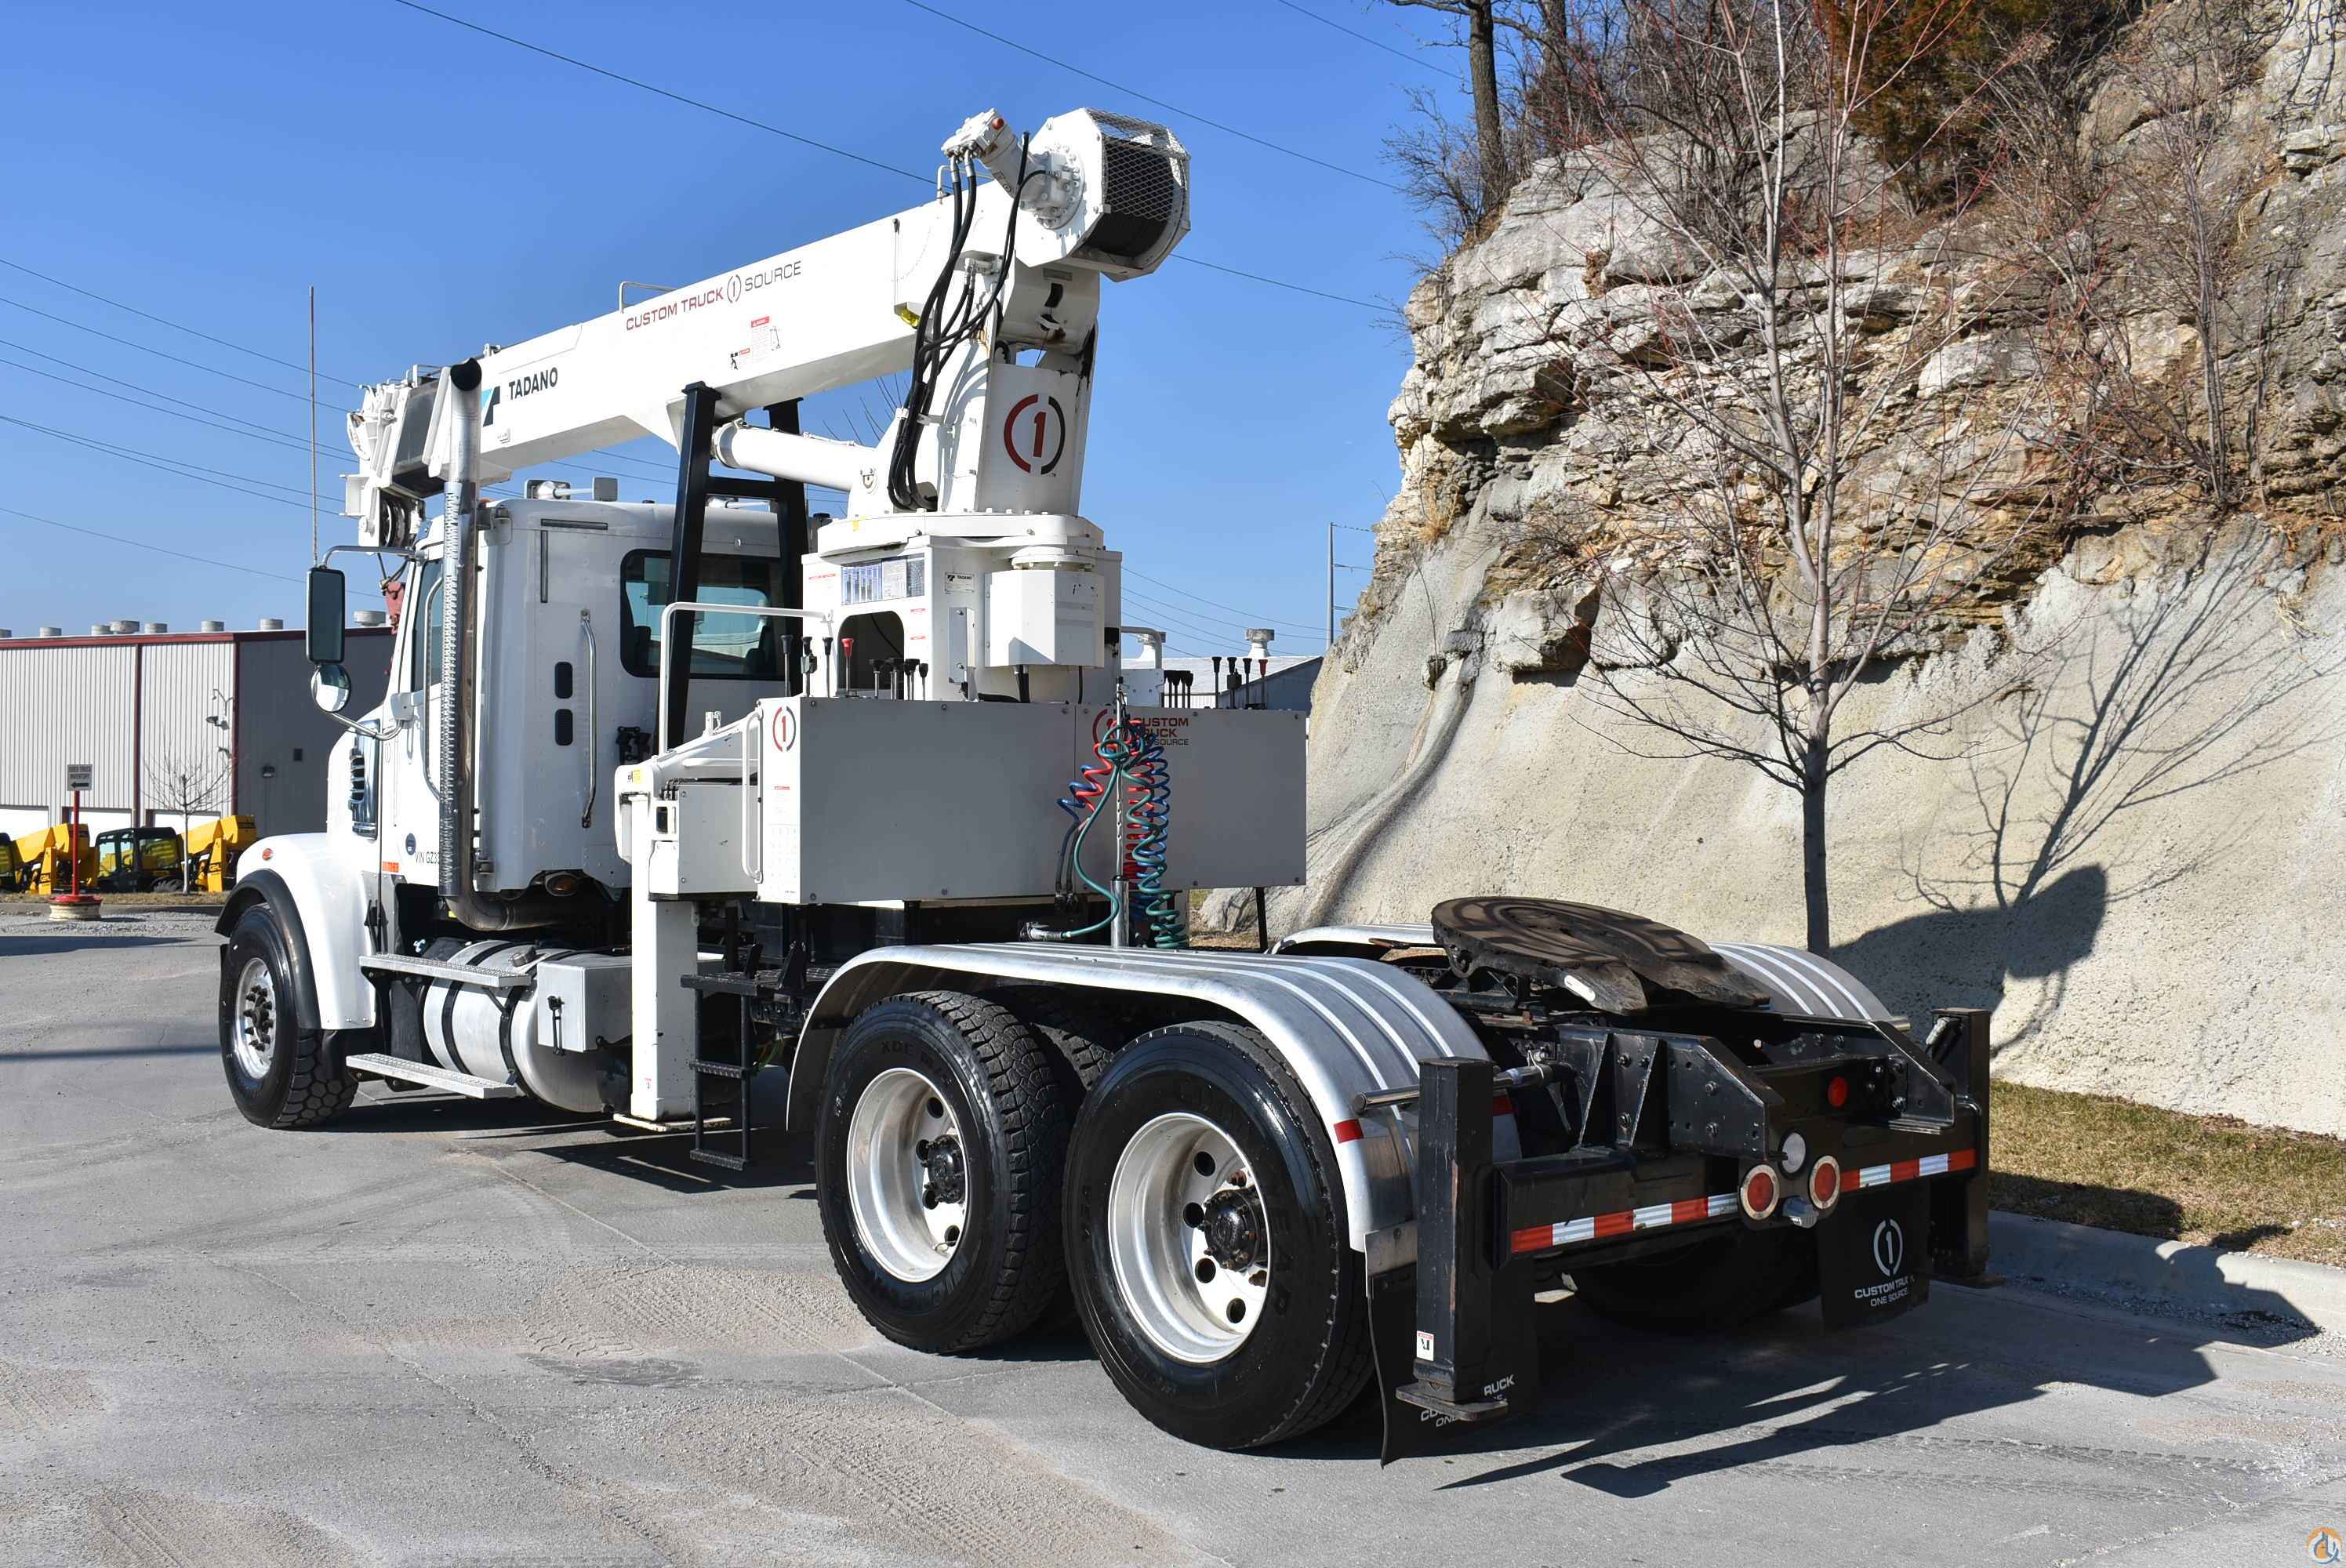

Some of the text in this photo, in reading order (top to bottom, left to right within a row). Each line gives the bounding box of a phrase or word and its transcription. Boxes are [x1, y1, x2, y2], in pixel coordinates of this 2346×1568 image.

[626, 303, 677, 330] CUSTOM
[681, 287, 724, 312] TRUCK
[744, 261, 801, 291] SOURCE
[508, 367, 558, 400] TADANO
[1144, 728, 1177, 738] RUCK
[415, 852, 424, 864] VIN
[1854, 1281, 1895, 1298] CUSTOM
[1870, 1295, 1887, 1307] ONE
[1484, 1374, 1516, 1396] RUCK
